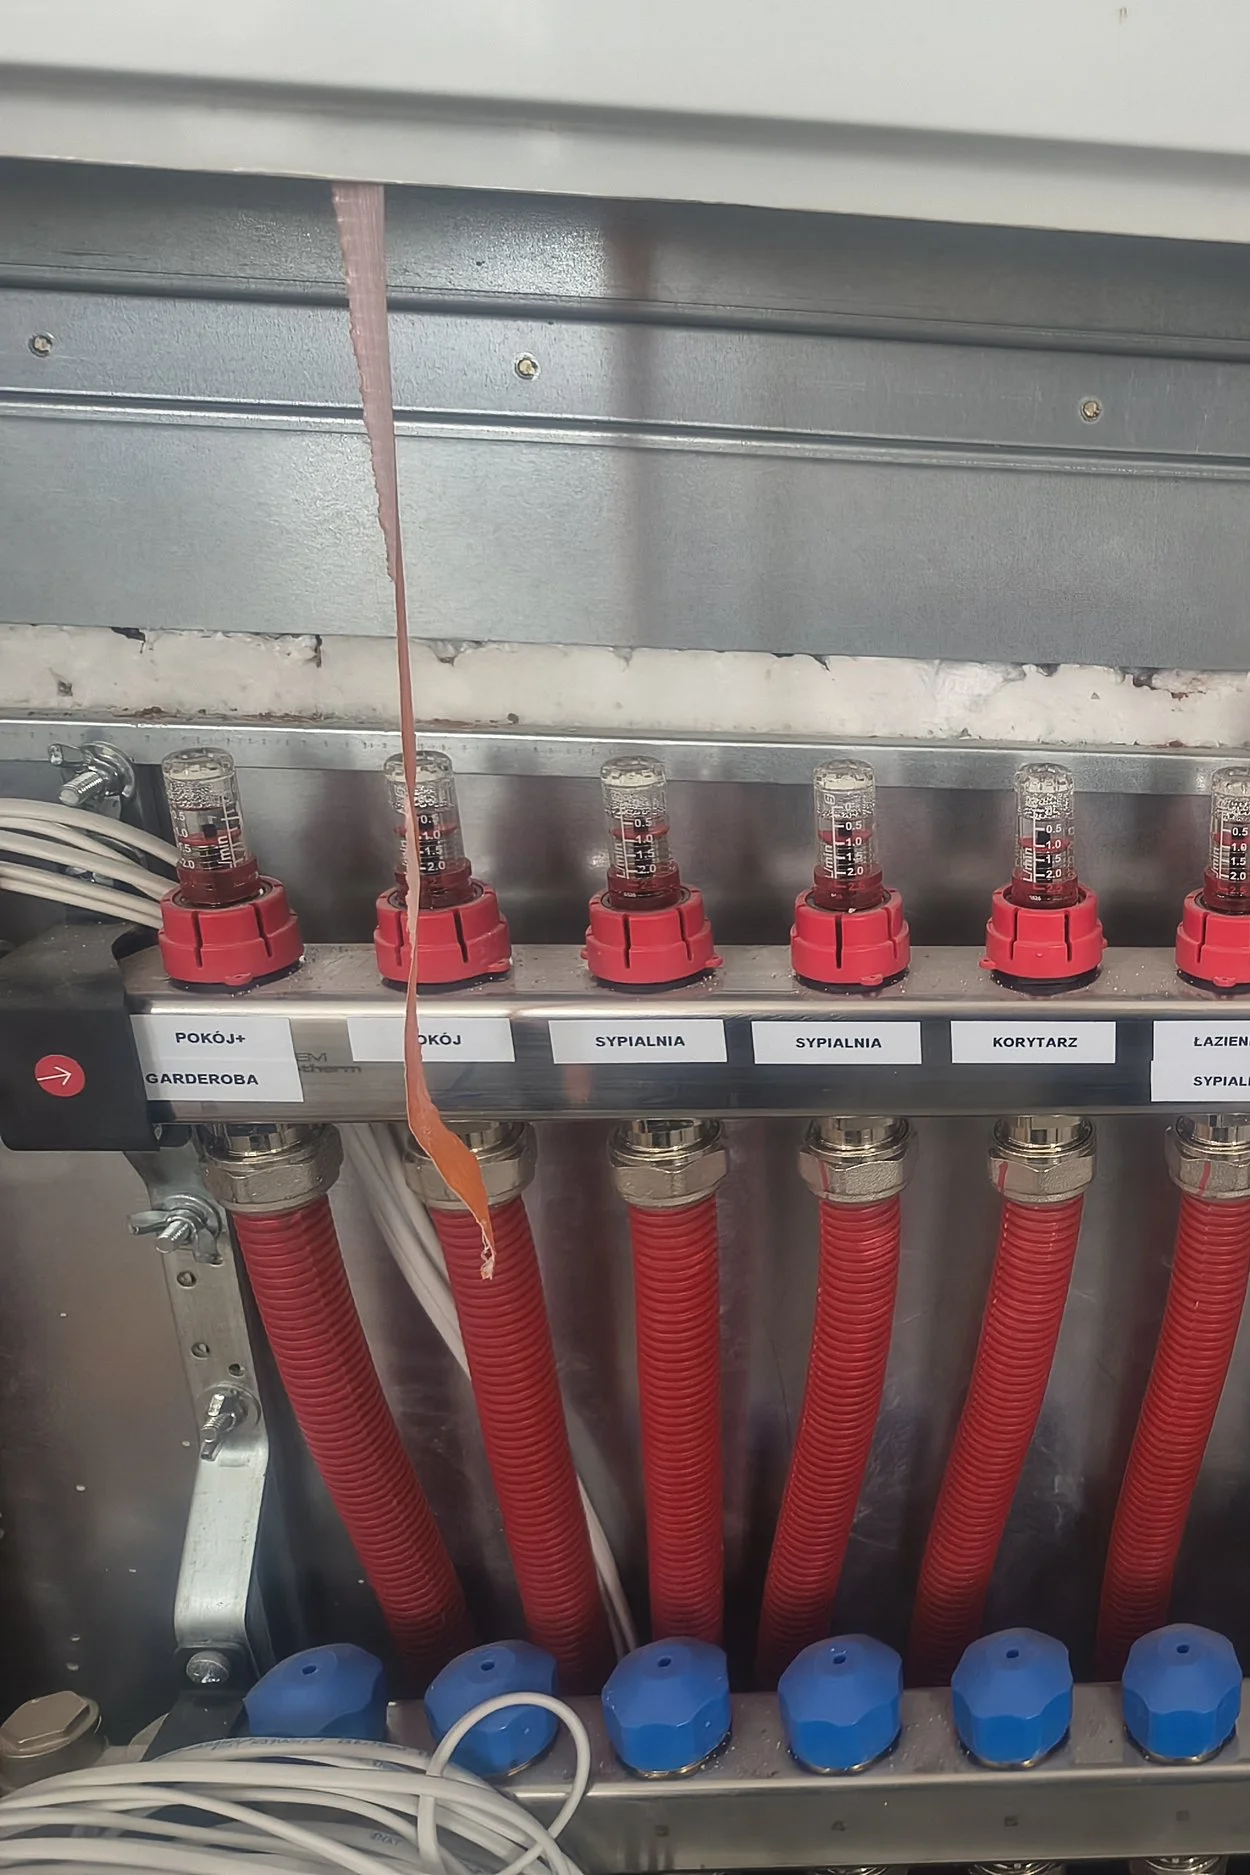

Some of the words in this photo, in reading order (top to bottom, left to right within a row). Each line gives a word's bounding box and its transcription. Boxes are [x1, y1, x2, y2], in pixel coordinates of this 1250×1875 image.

[420, 813, 439, 824] 0.5
[634, 818, 652, 828] 0.5
[845, 821, 862, 831] 0.5
[1046, 825, 1062, 834] 0.5
[1232, 827, 1249, 837] 0.5
[635, 834, 653, 844] 1.0
[845, 837, 862, 847] 1.0
[1046, 839, 1062, 849] 1.0
[424, 845, 443, 856] 1.5
[1231, 843, 1247, 852] 1.0
[636, 849, 655, 859] 1.5
[846, 852, 863, 862] 1.5
[1046, 854, 1062, 864] 1.5
[427, 860, 446, 871] 2.0
[615, 843, 626, 879] L/min
[824, 844, 834, 879] L/min
[1022, 847, 1033, 882] L/min
[1230, 857, 1246, 866] 1.5
[637, 864, 657, 874] 2.0
[847, 866, 864, 876] 2.0
[1046, 868, 1062, 879] 2.0
[1229, 871, 1247, 881] 2.0
[175, 1030, 246, 1045] POKÓJ+
[417, 1032, 462, 1046] OKÓJ
[595, 1035, 686, 1048] SYPIALNIA
[992, 1036, 1078, 1049] KORYTARZ
[795, 1037, 882, 1049] SYPIALNIA
[145, 1072, 259, 1086] GARDEROBA
